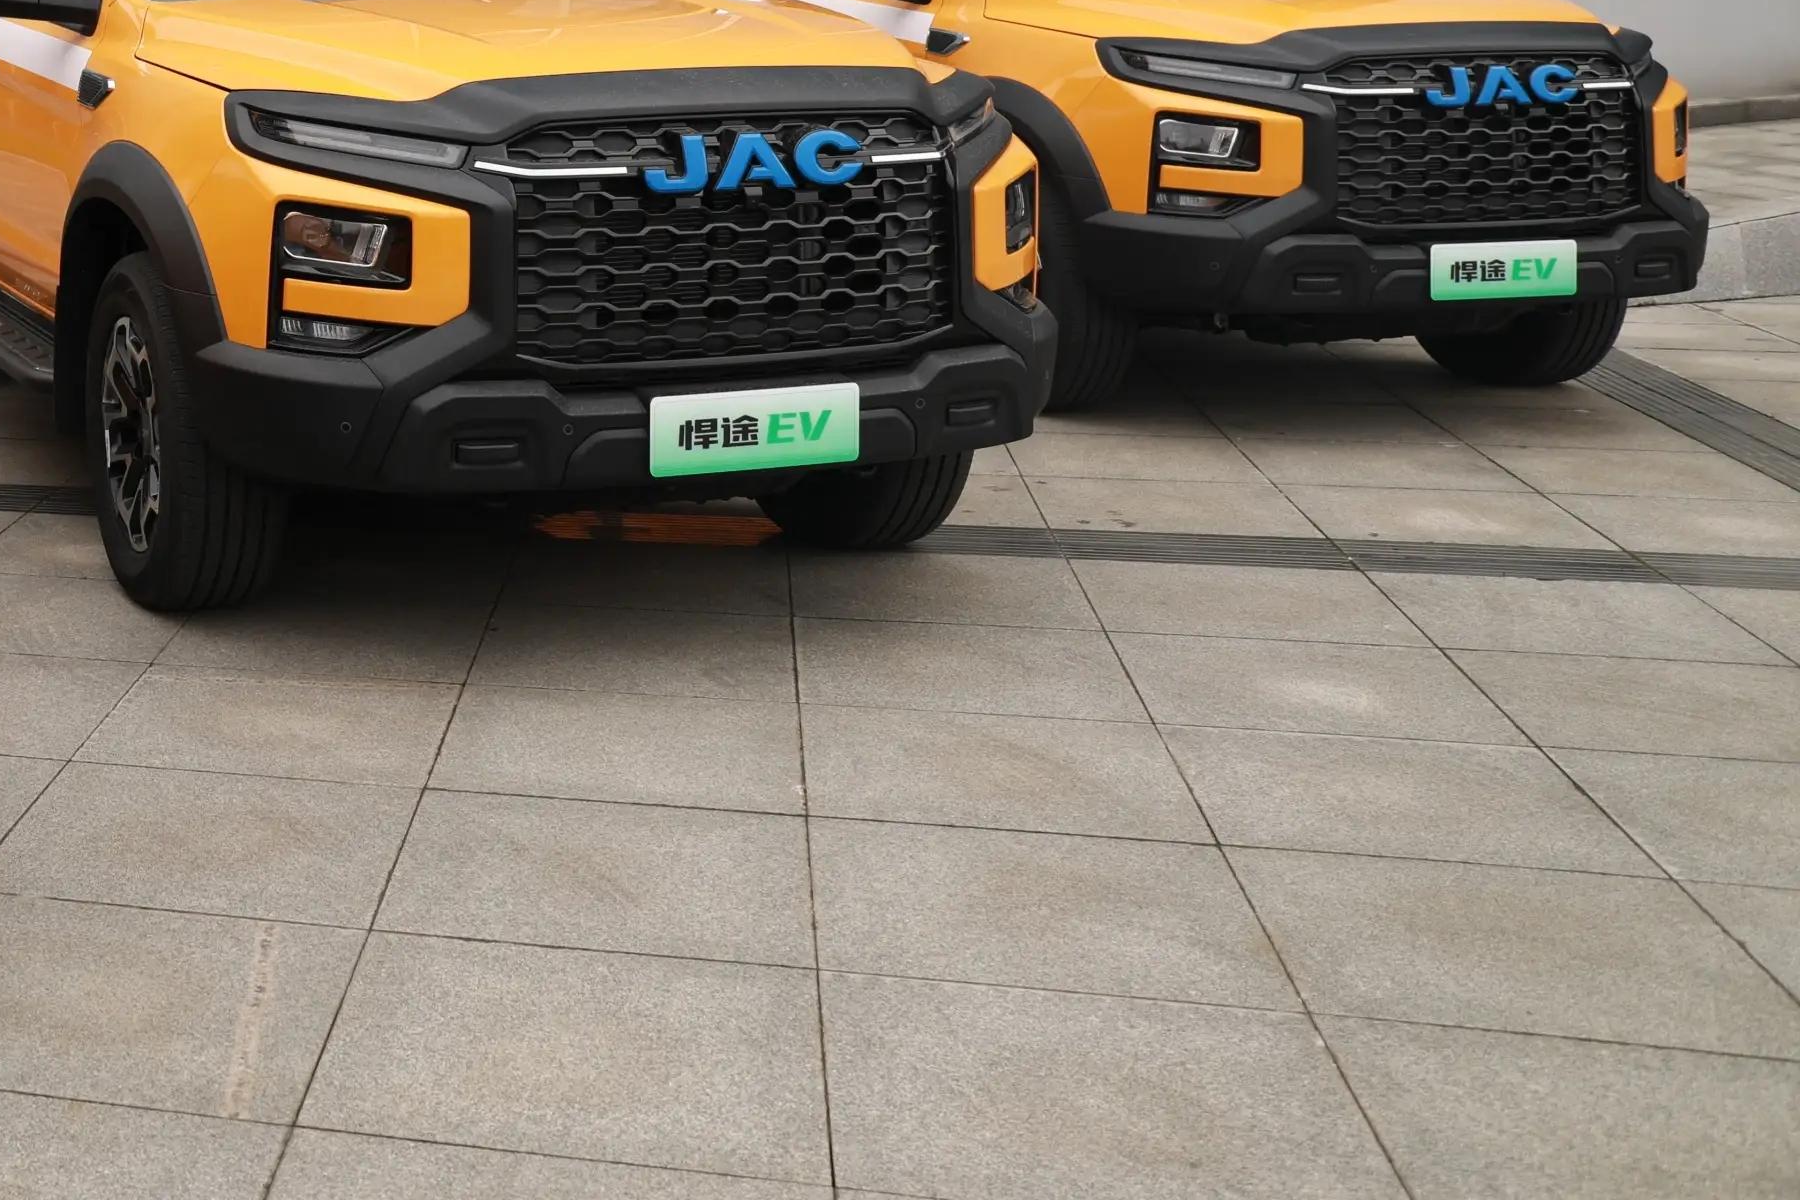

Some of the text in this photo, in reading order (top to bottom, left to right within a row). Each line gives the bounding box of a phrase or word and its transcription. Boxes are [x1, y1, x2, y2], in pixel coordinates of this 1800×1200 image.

[1425, 63, 1579, 107] JAC
[643, 129, 864, 194] JAC
[1450, 257, 1558, 283] 悍途 EV
[678, 410, 832, 451] 悍途 EV
